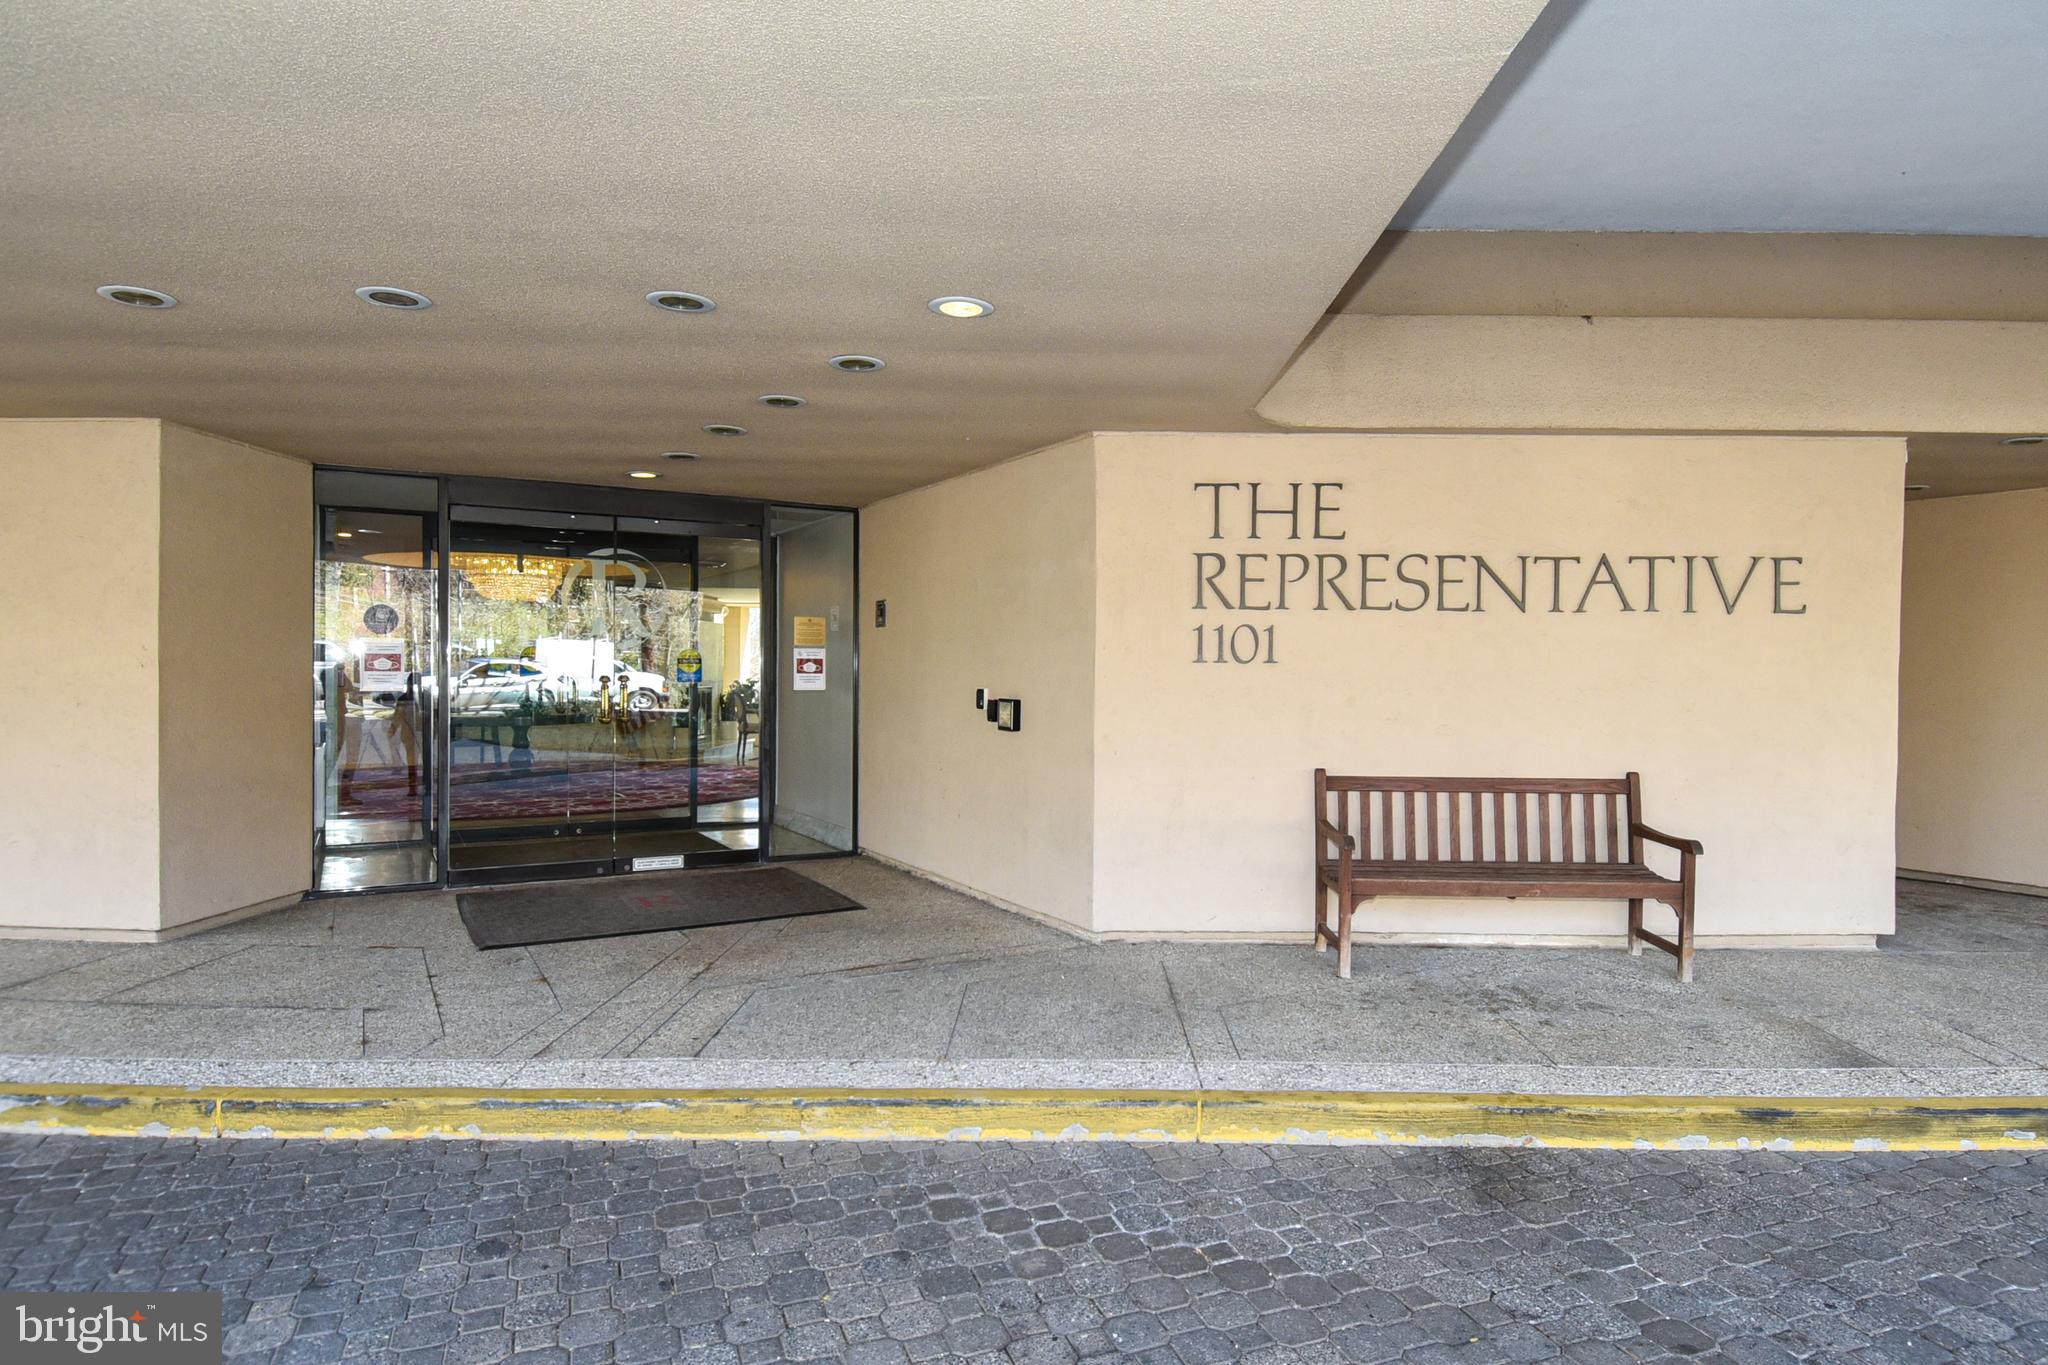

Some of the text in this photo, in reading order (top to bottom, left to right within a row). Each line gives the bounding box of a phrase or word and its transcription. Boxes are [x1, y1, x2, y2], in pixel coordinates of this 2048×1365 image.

[1194, 483, 1345, 540] THE
[1191, 552, 1807, 616] REPRESENTATIVE
[1192, 624, 1278, 665] 1101
